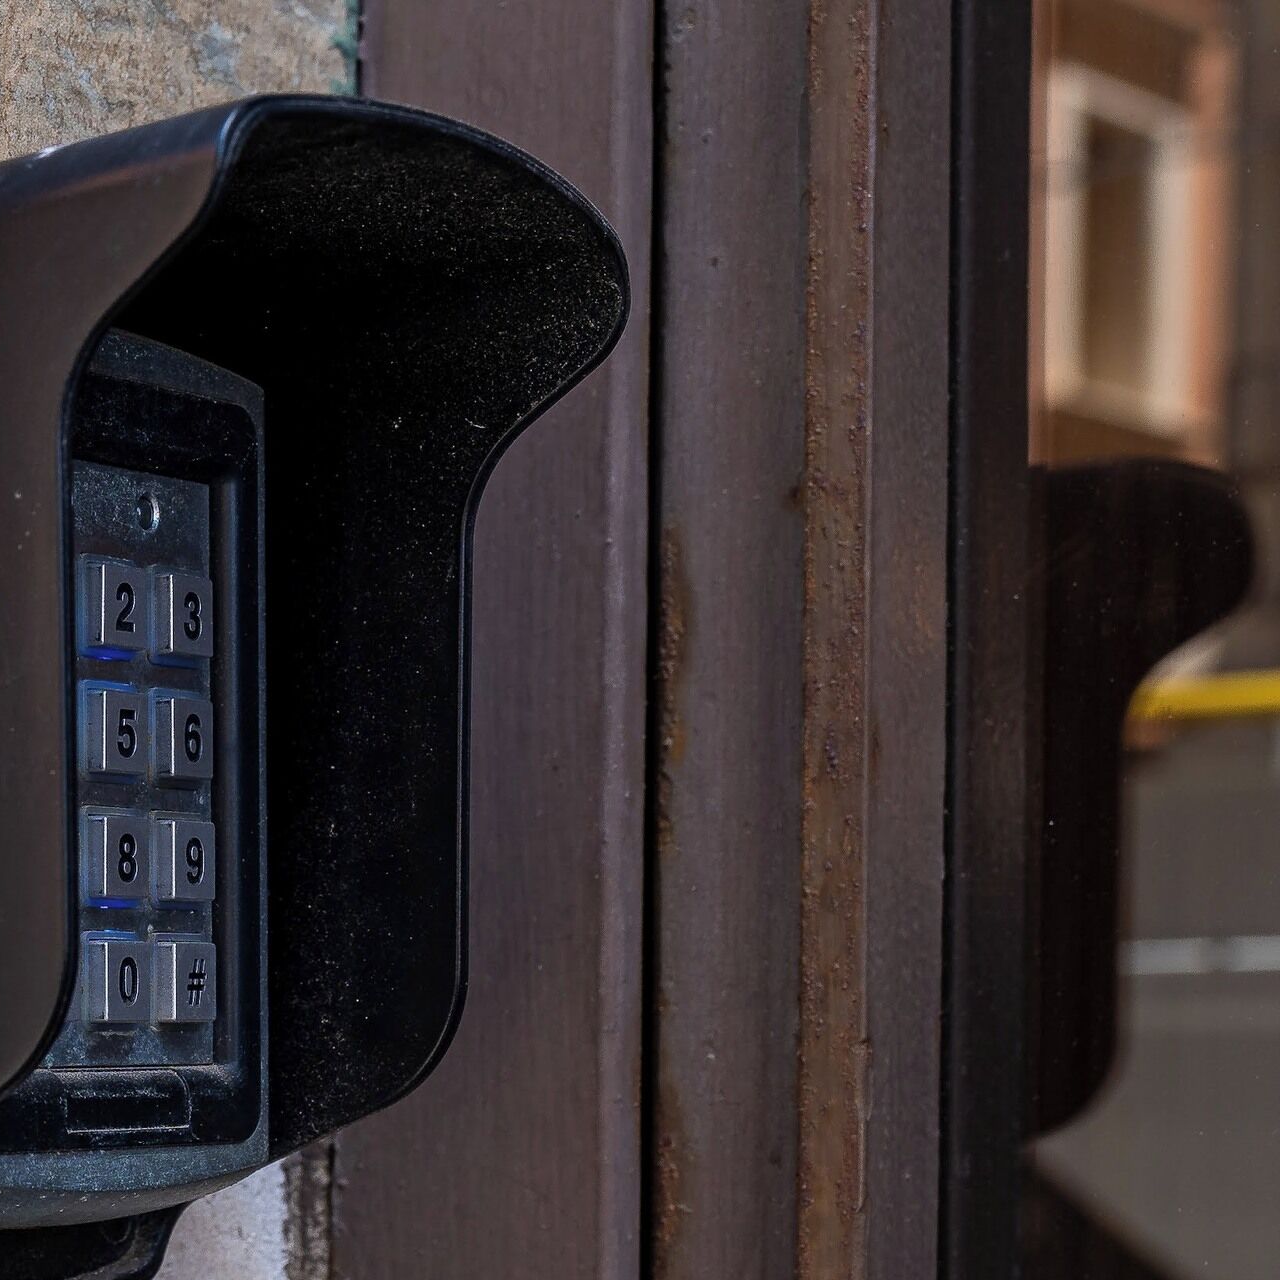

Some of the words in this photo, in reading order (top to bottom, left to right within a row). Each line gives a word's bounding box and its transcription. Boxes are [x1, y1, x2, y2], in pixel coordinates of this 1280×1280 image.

[115, 582, 137, 633] 2
[183, 591, 203, 642] 3
[116, 708, 138, 759] 5
[184, 713, 203, 763] 6
[117, 833, 139, 883] 8
[185, 837, 205, 885] 9
[118, 956, 139, 1007] 0
[187, 957, 208, 1007] #
